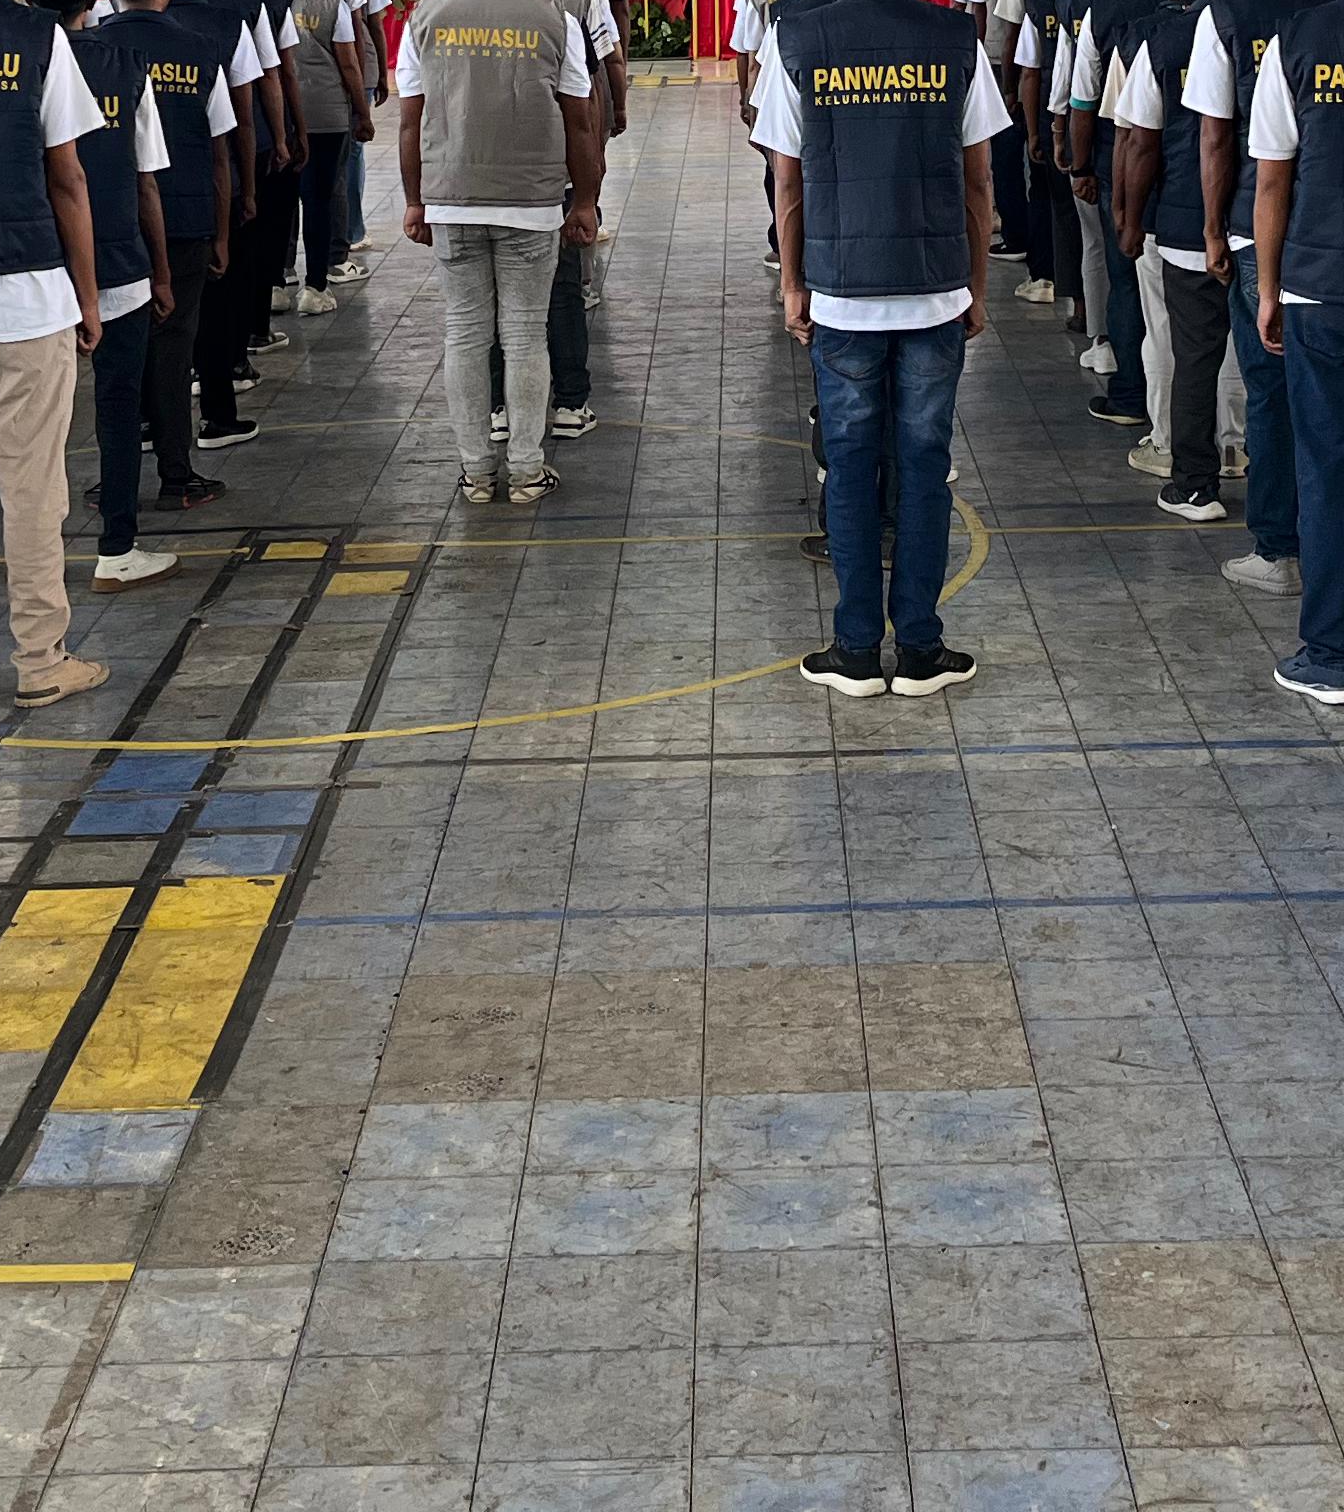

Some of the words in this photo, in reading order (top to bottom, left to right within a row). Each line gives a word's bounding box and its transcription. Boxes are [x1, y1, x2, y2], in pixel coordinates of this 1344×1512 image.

[435, 28, 539, 49] PANWASLU
[434, 49, 538, 59] KECAMATAN
[146, 63, 198, 85] ASLU
[813, 64, 947, 92] PANWASLU
[814, 92, 947, 106] KELURAHAN/DESA
